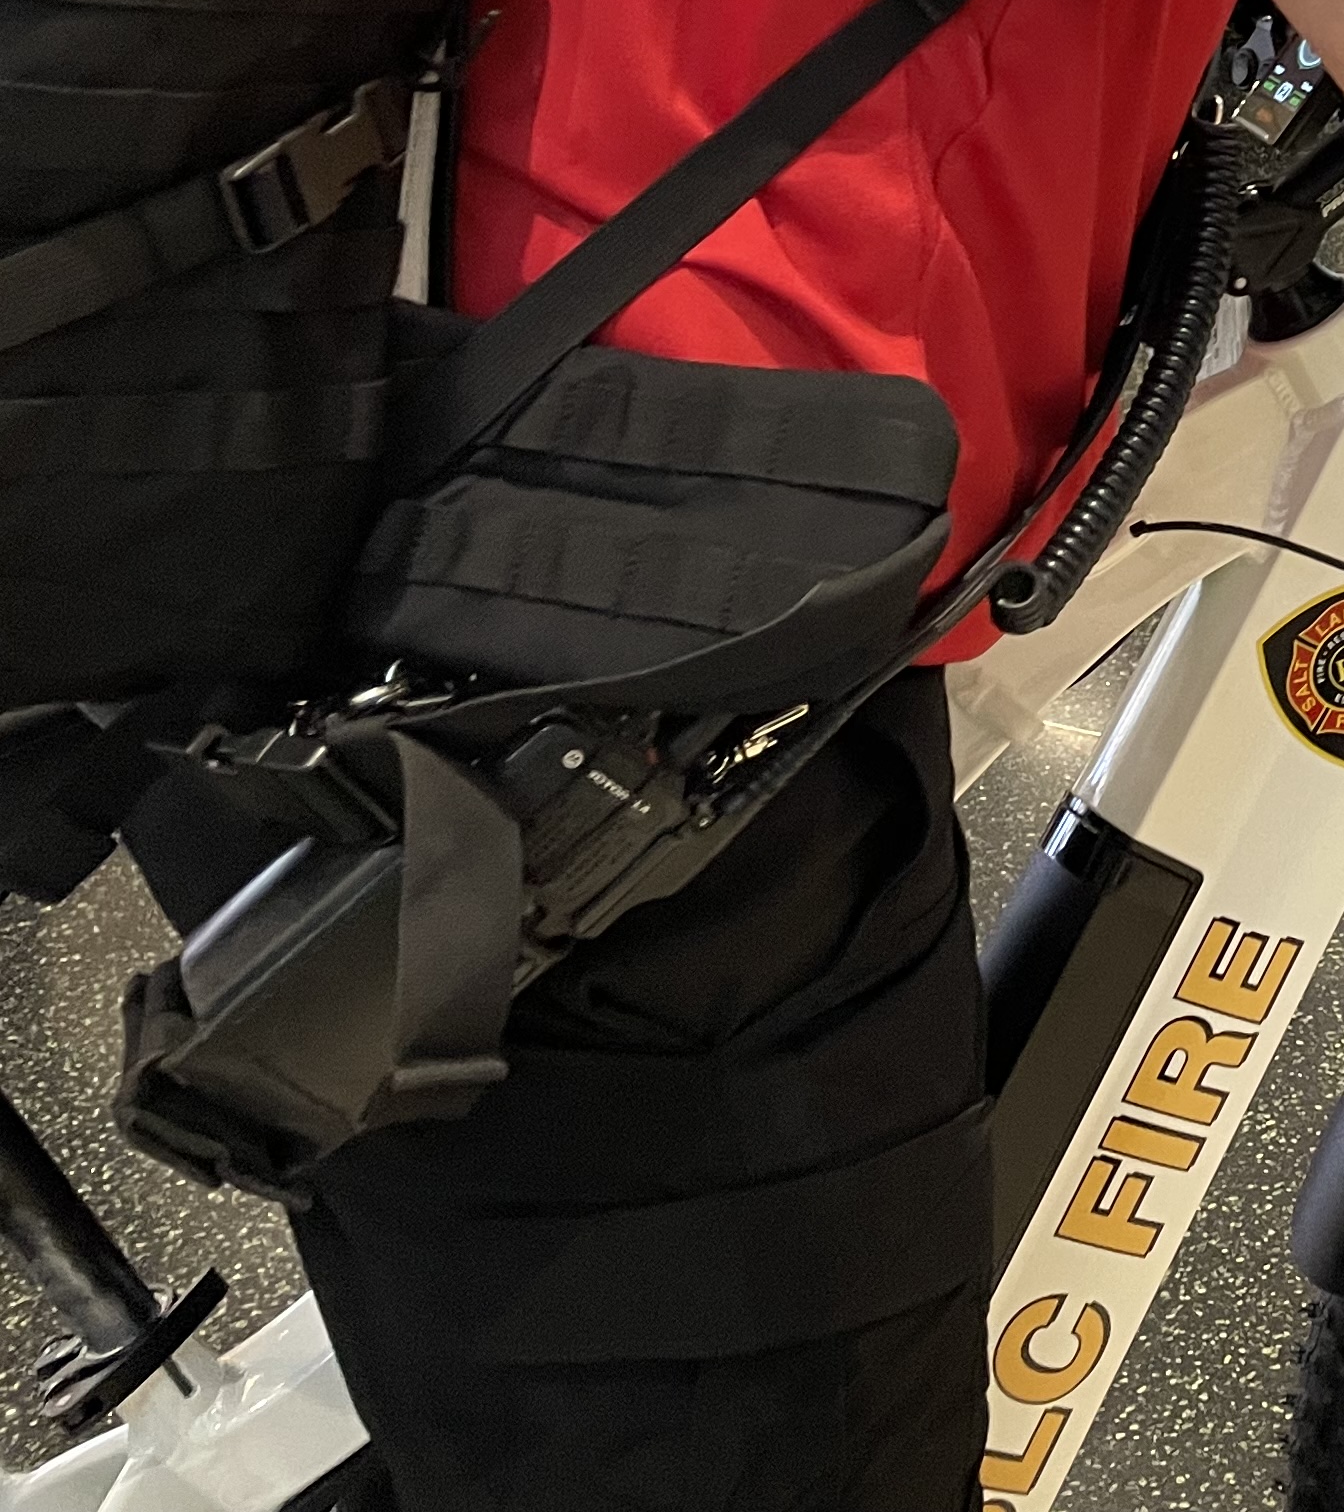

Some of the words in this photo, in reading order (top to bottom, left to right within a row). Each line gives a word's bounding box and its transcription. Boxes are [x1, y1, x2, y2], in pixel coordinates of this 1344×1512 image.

[1292, 660, 1317, 712] SALT
[978, 1292, 1112, 1512] LC
[1055, 915, 1305, 1259] FIRE
